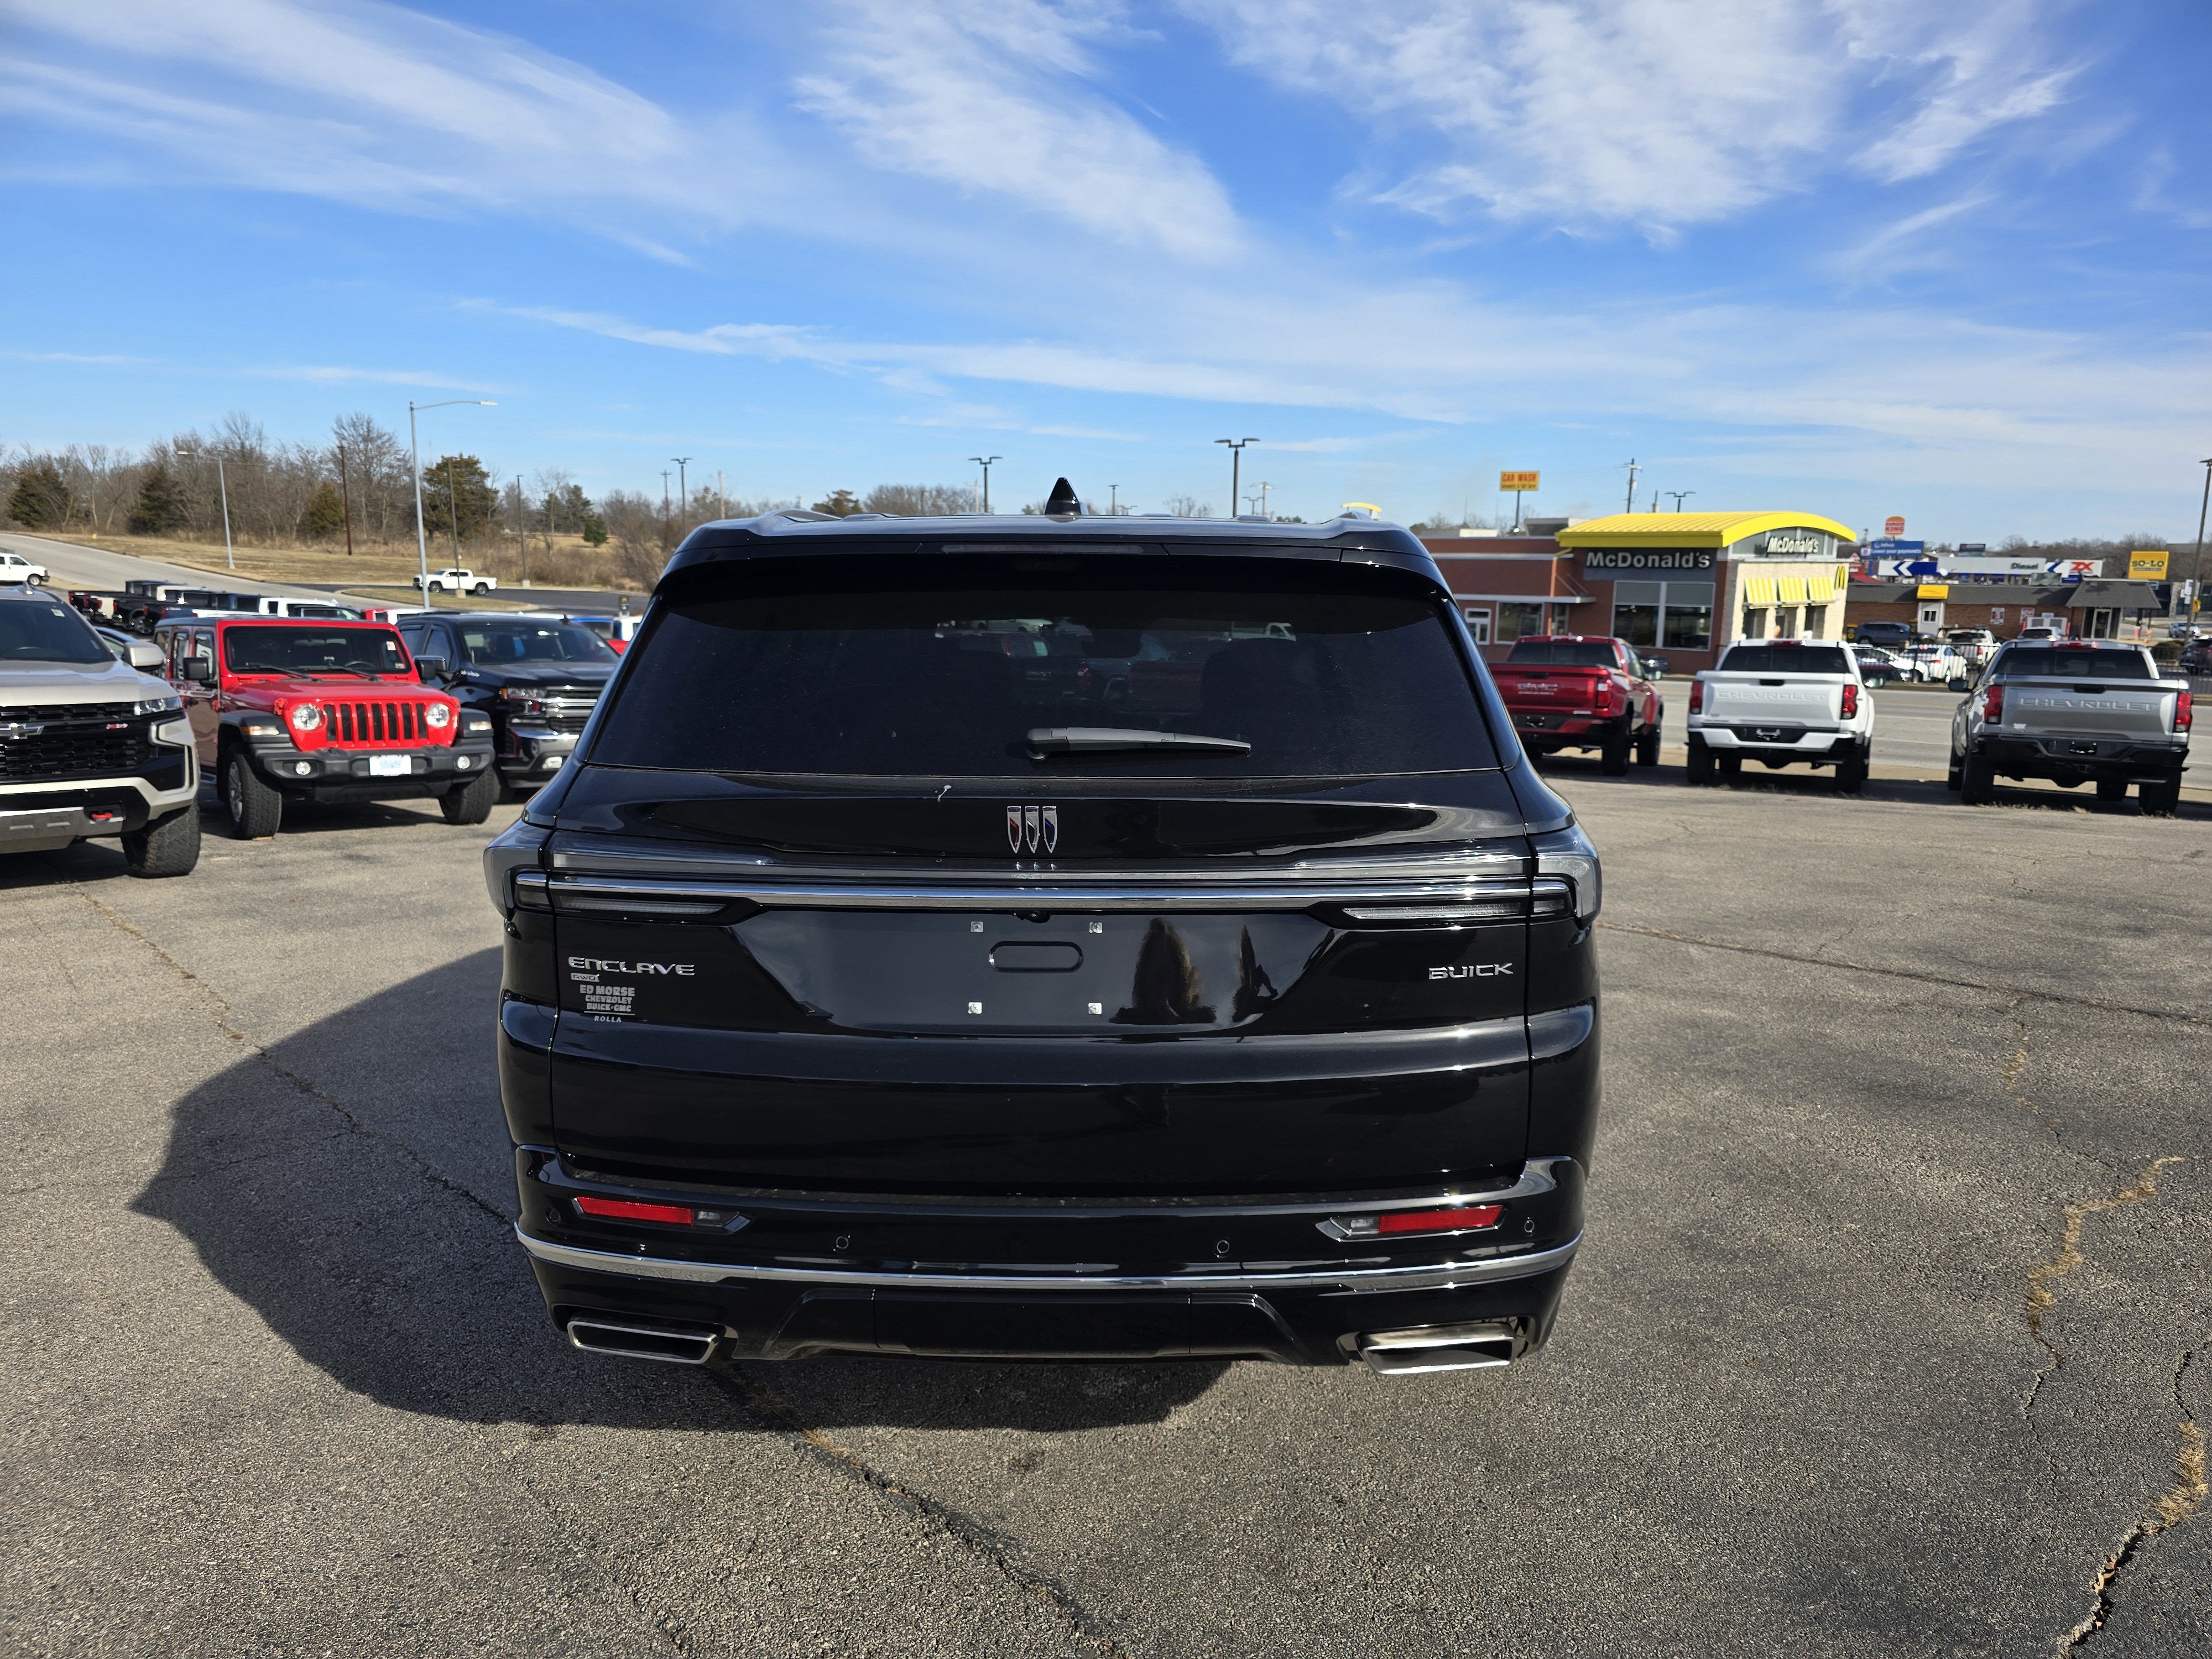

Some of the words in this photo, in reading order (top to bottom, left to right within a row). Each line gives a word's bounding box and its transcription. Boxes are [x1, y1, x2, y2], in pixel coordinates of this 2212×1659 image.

[1768, 536, 1820, 554] McDonald's
[1585, 551, 1711, 569] McDonald's
[1715, 690, 1827, 702] CHEVROLET
[2018, 697, 2157, 712] CHEVROLET
[568, 956, 695, 976] ENCLAVE
[1428, 963, 1514, 980] BUICK
[580, 984, 594, 994] ED
[596, 985, 635, 997] MORSE
[585, 995, 633, 1005] CHEVROLET
